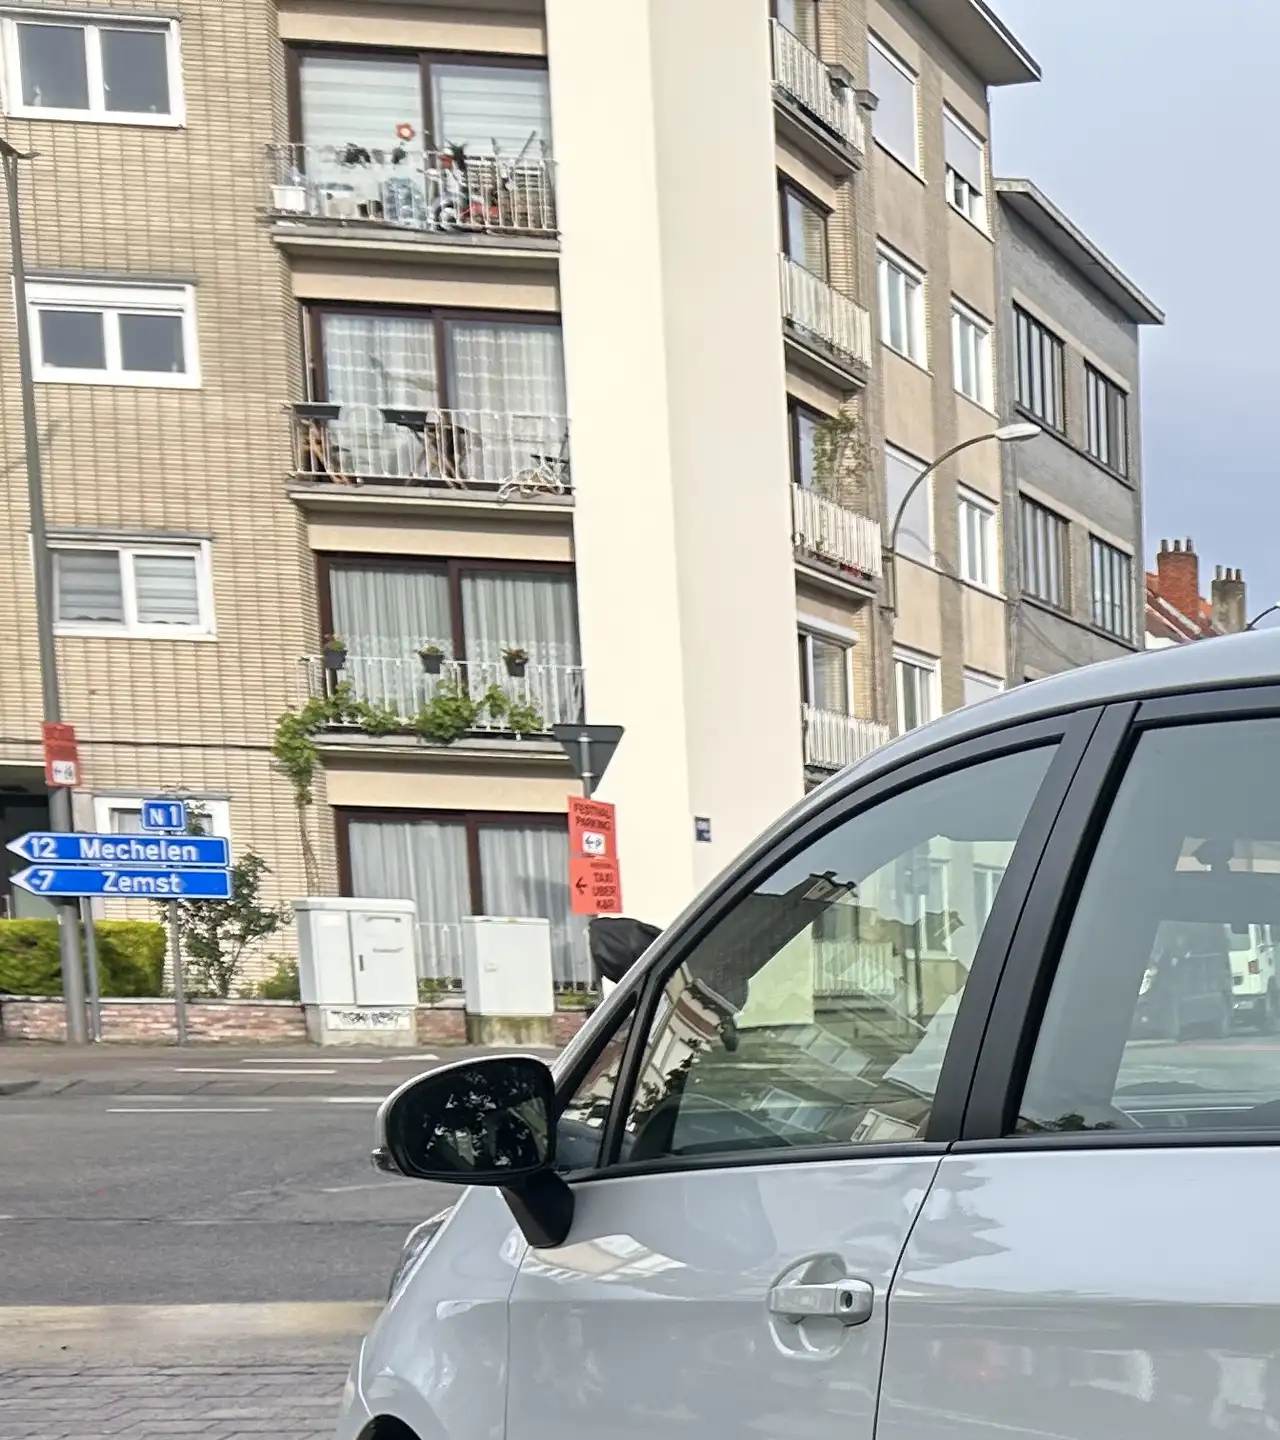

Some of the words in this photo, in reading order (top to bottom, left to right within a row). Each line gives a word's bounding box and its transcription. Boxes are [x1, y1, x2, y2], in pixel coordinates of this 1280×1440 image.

[150, 808, 164, 826] N
[169, 808, 178, 826] 1
[30, 837, 59, 859] 12
[79, 838, 199, 862] Mechelen
[101, 871, 182, 894] Zemst
